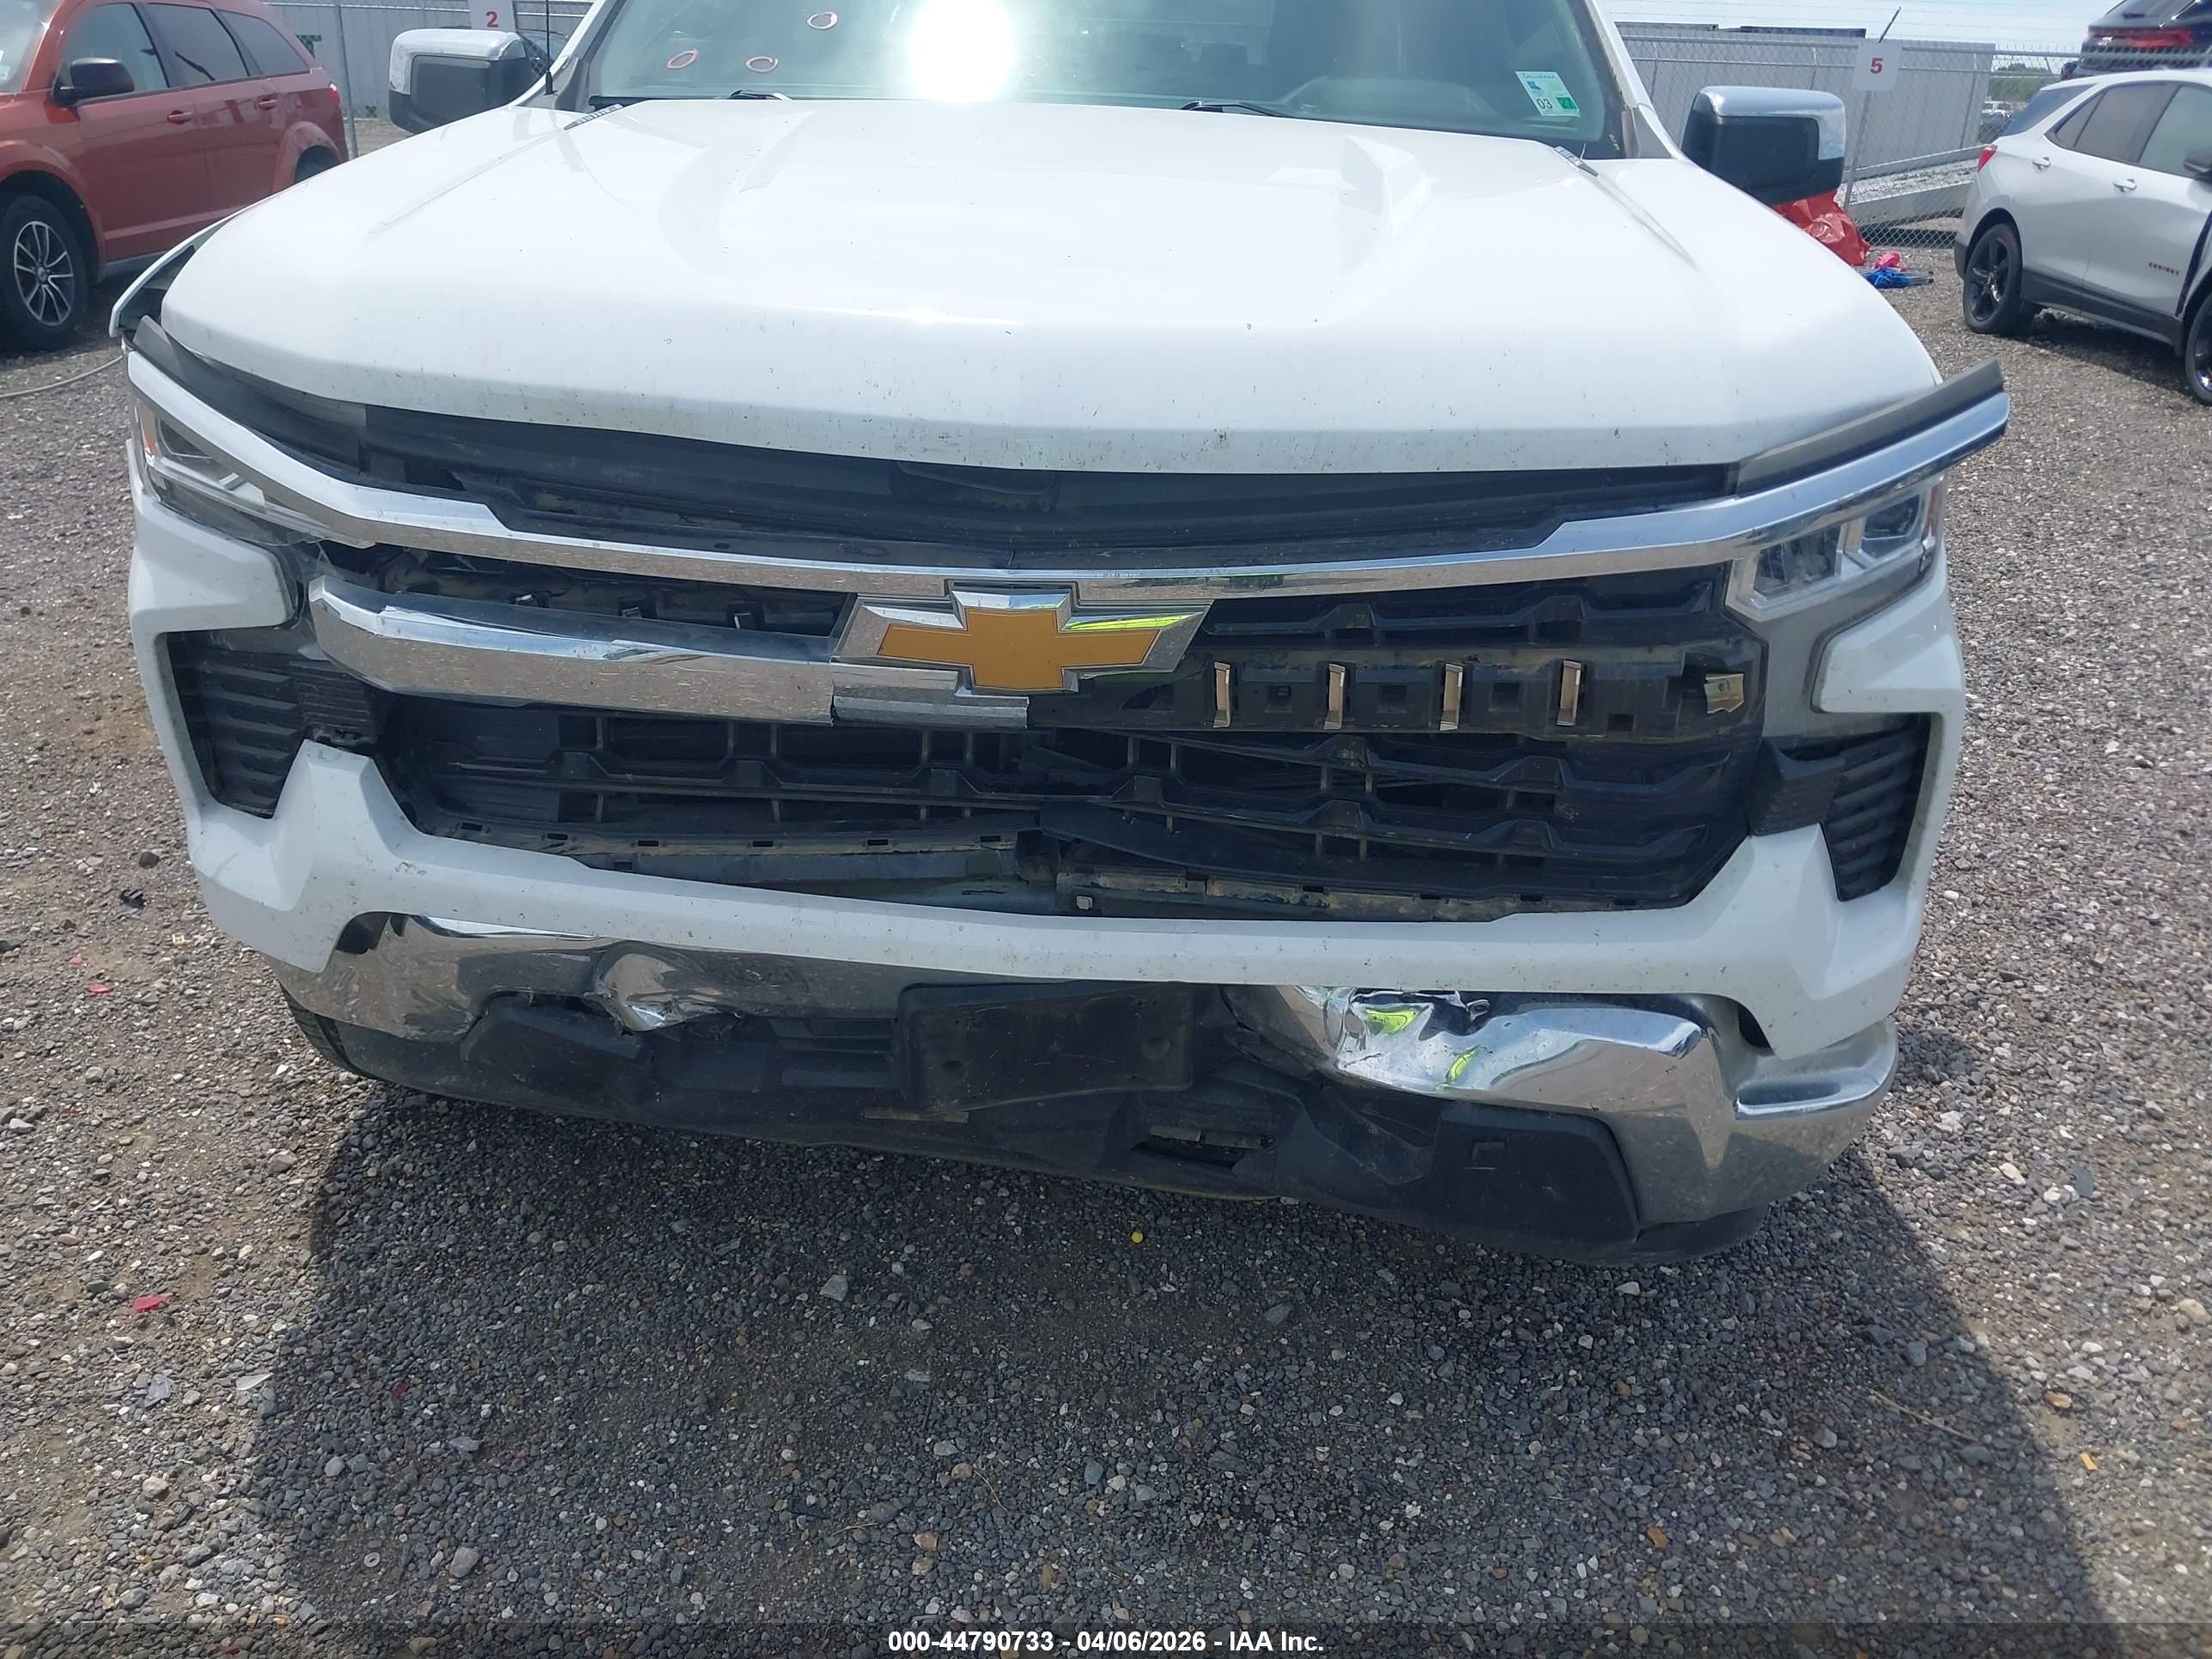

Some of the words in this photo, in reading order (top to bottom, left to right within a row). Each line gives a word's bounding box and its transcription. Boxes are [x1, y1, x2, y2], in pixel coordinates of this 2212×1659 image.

[485, 11, 499, 27] 2
[1870, 58, 1883, 74] 5
[1536, 98, 1553, 109] 03
